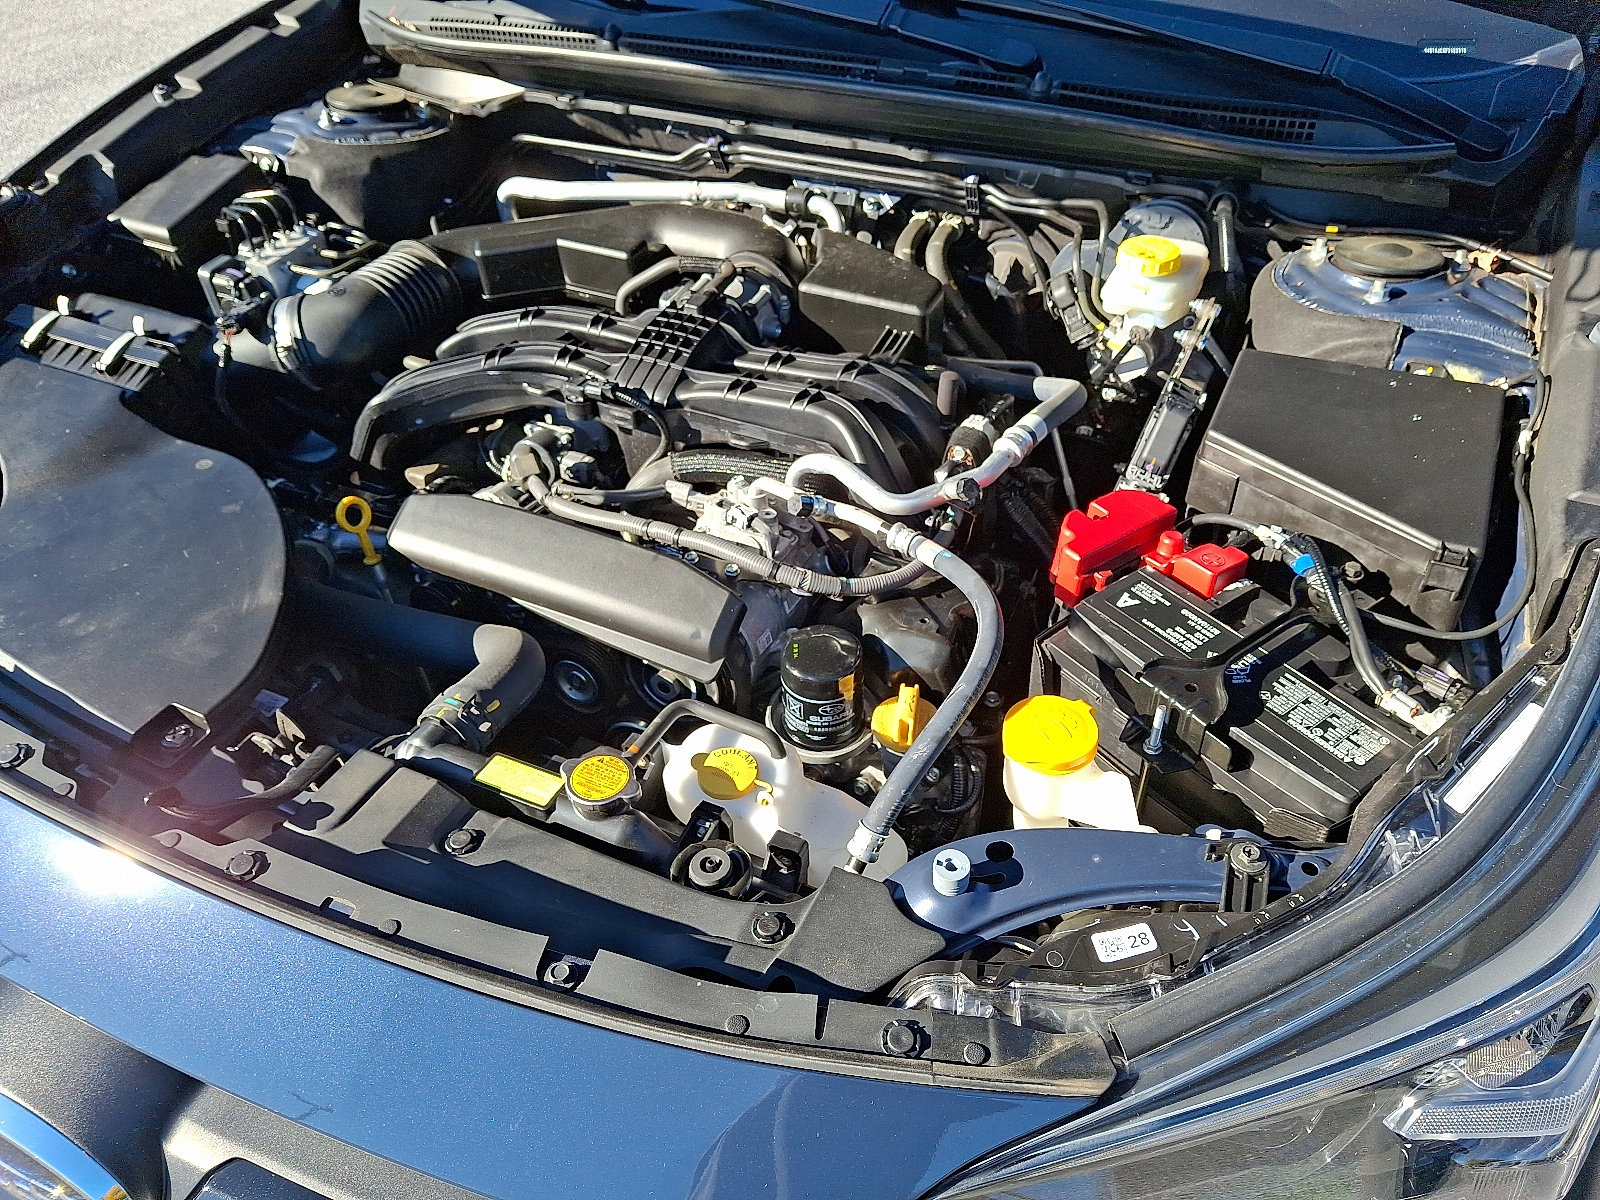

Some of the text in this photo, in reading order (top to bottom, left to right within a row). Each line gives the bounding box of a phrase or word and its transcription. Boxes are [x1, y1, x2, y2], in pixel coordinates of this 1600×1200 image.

[1141, 618, 1156, 629] AMPS
[1166, 628, 1186, 642] AMPS
[1178, 642, 1192, 653] COLD
[1127, 932, 1150, 949] 28
